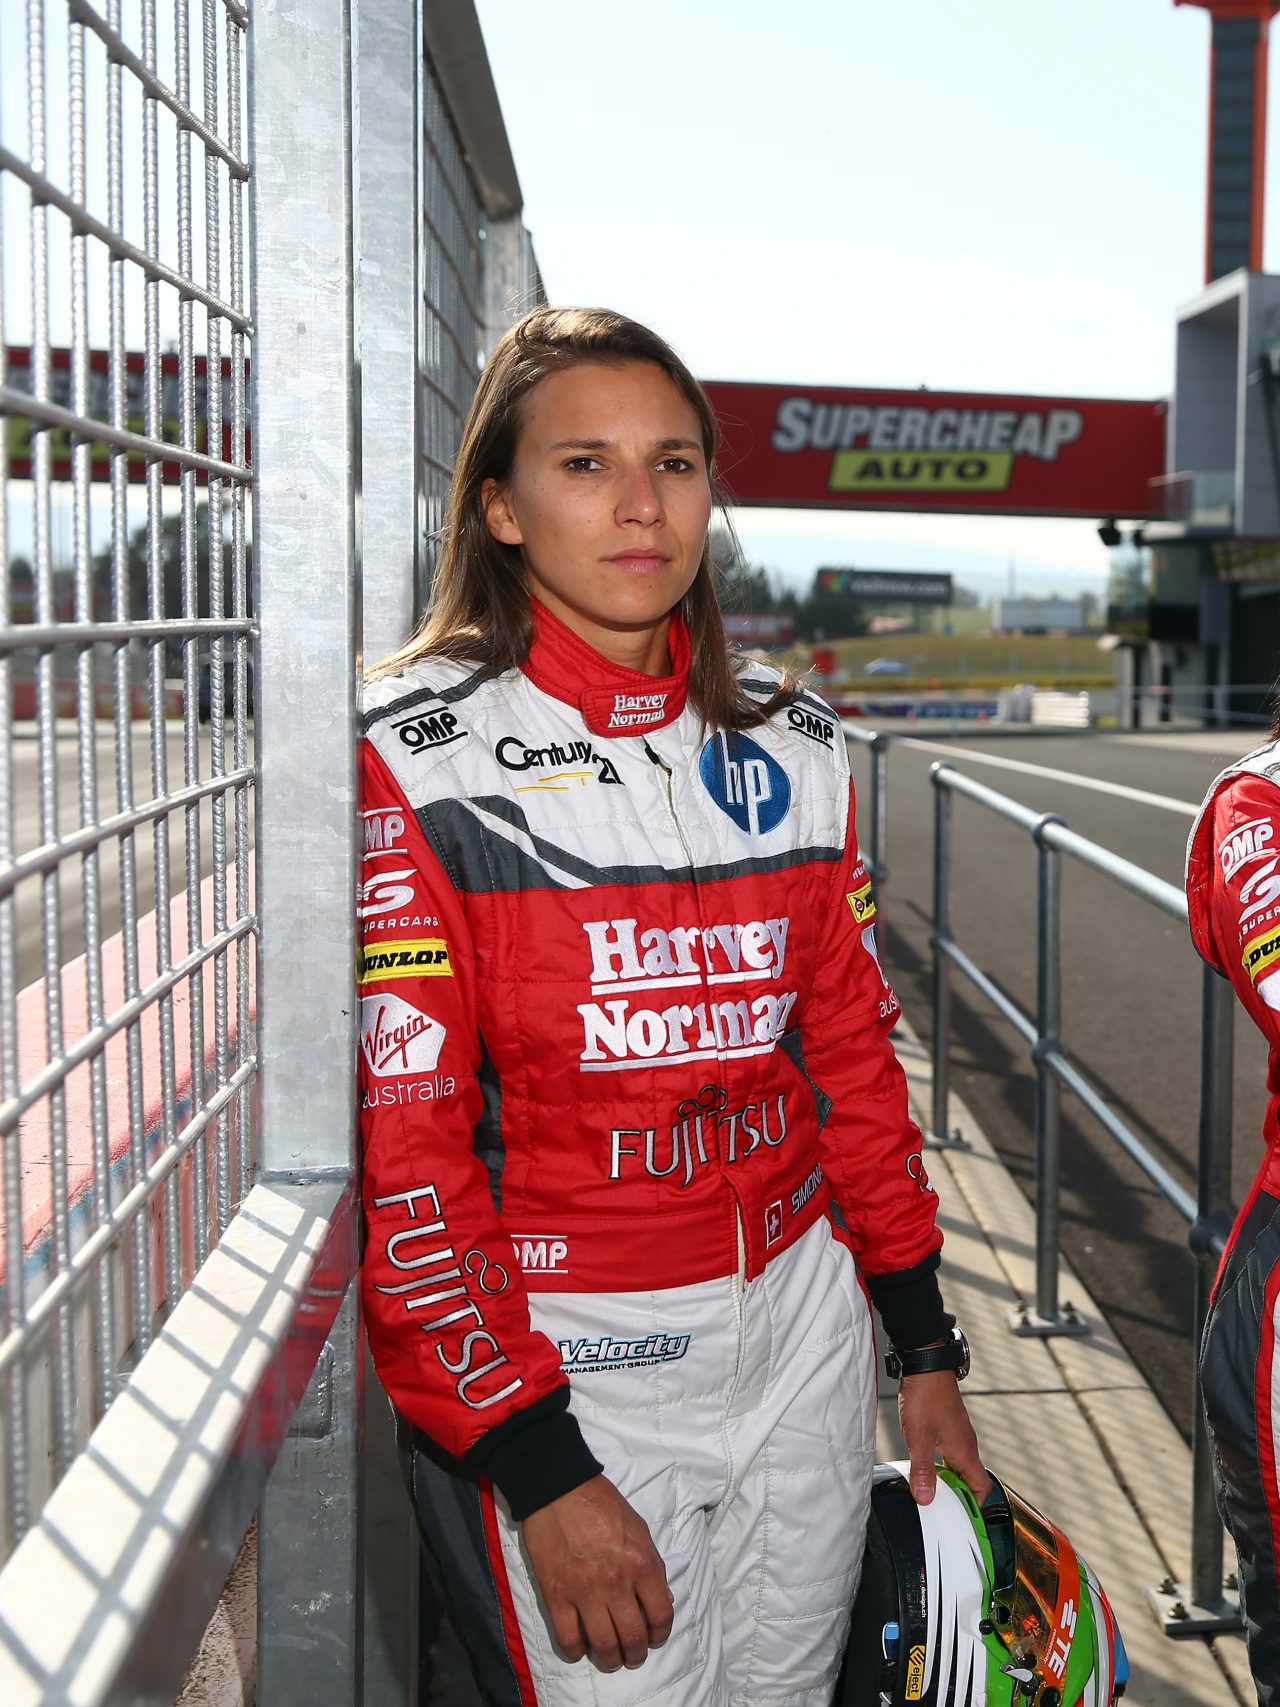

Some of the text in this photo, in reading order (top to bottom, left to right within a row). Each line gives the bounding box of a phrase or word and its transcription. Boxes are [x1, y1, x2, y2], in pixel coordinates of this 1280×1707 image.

[771, 397, 1083, 461] SUPERCHEAP
[854, 458, 989, 482] AUTO
[608, 709, 664, 727] Norman
[615, 693, 668, 710] Harvey
[399, 711, 457, 748] OMP
[787, 708, 834, 742] OMP
[495, 736, 625, 785] Century 21
[720, 731, 772, 836] hp
[364, 816, 404, 849] MP
[1221, 824, 1274, 875] OMP
[364, 950, 448, 971] UNLOP
[583, 917, 790, 982] Harvey
[365, 1005, 432, 1069] Virgin
[576, 991, 798, 1061] Norman
[609, 1094, 786, 1189] FUJITSU
[513, 1241, 567, 1268] MP
[373, 1182, 523, 1411] FUJITSU
[559, 1333, 692, 1364] Velocity
[562, 1360, 660, 1375] MANAGEMENT GROUP
[1047, 1637, 1072, 1680] TE
[909, 1666, 921, 1694] eject
